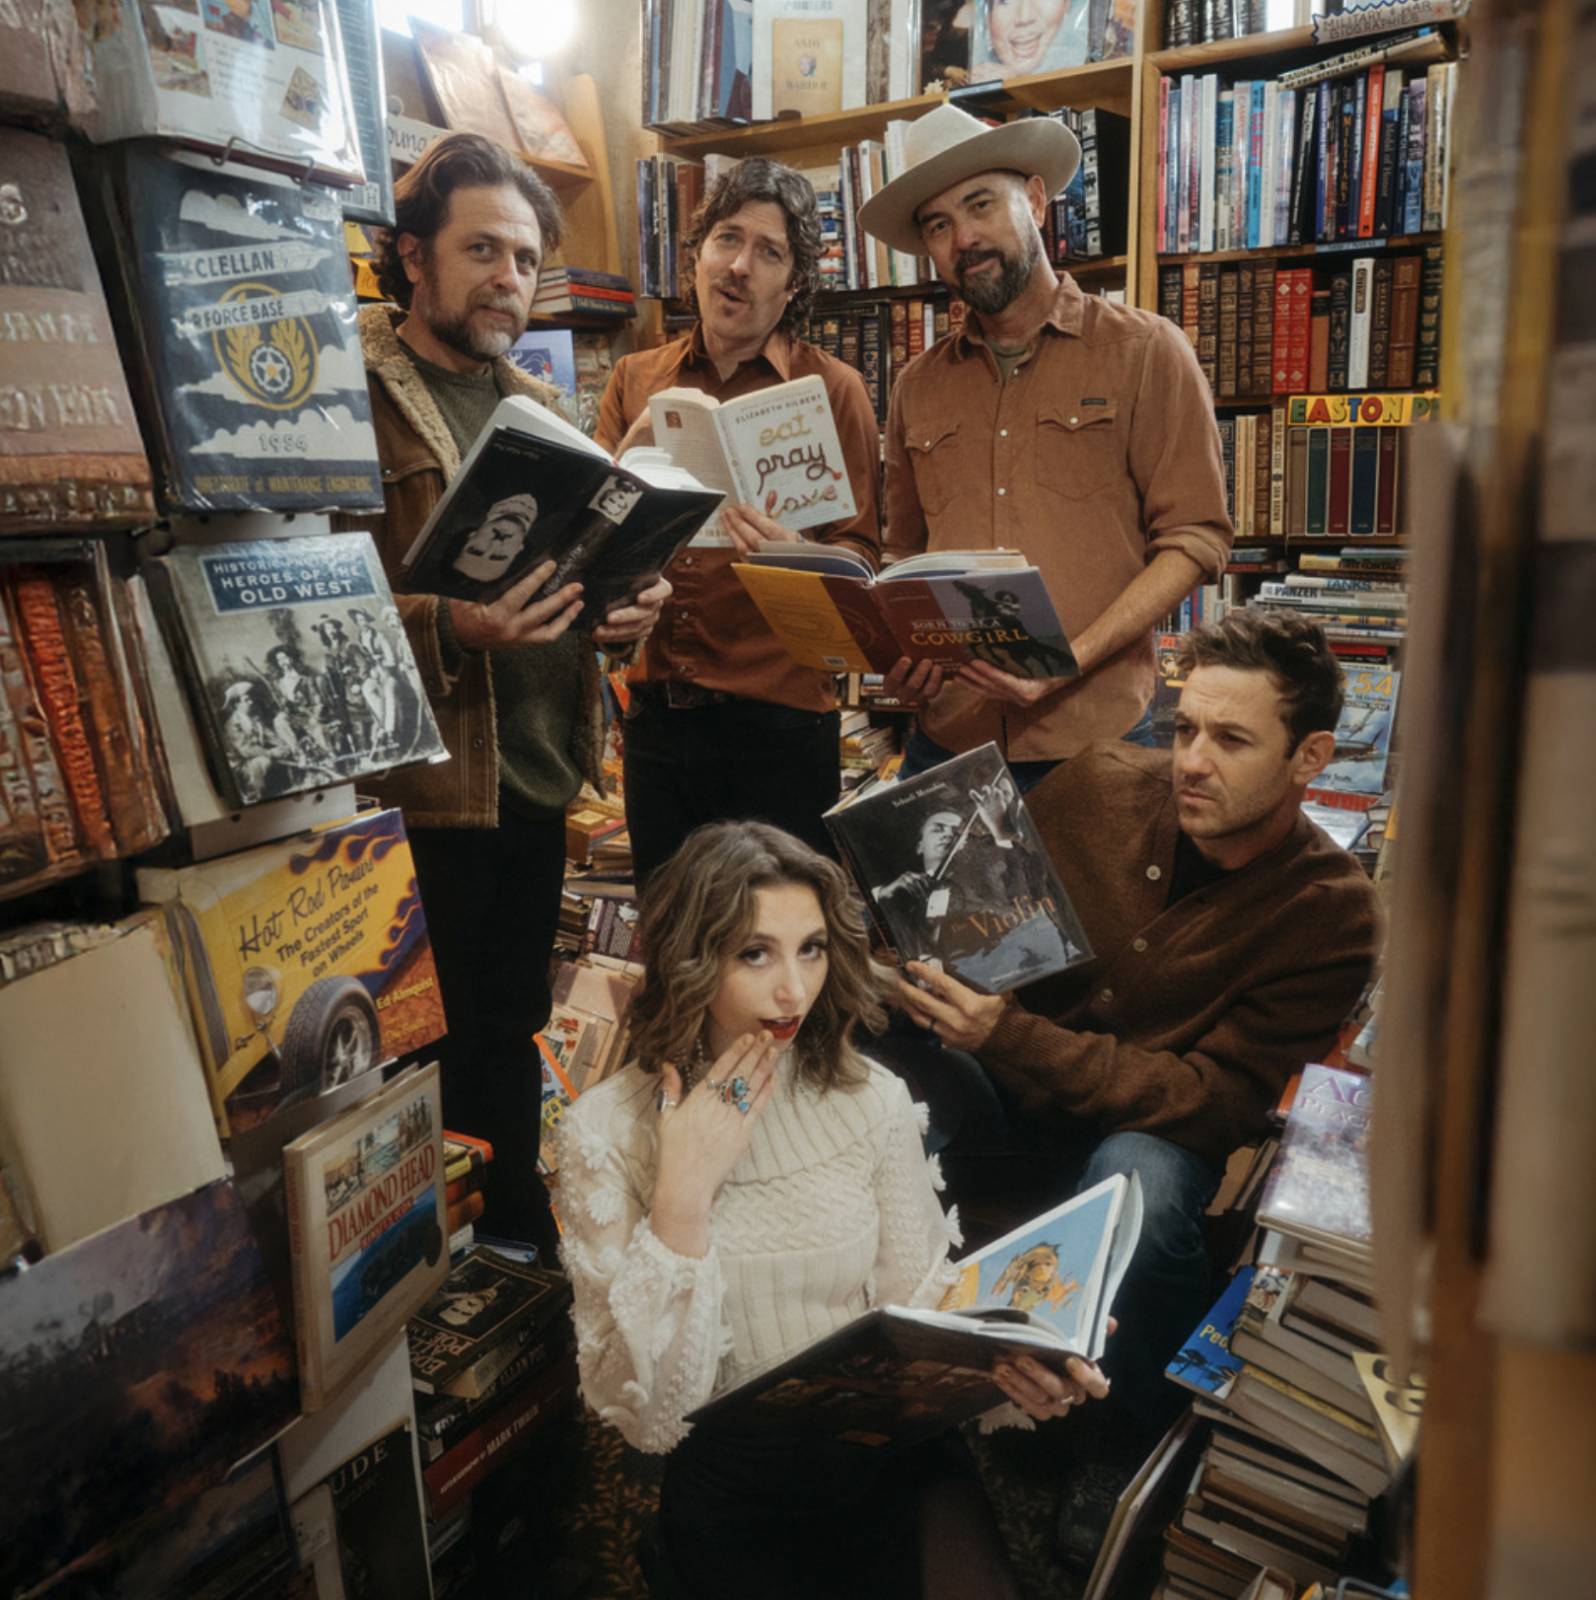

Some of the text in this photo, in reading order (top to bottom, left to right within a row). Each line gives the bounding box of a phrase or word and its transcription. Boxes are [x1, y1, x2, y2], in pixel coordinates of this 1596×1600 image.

[203, 304, 249, 327] FORCE
[251, 299, 285, 320] BASE
[735, 392, 822, 425] ELIZABETH GILBERT
[1290, 395, 1404, 424] EASTON
[758, 413, 812, 448] eat
[756, 443, 838, 497] pray
[763, 484, 838, 520] love
[220, 570, 294, 589] HEROES
[299, 568, 320, 582] OF
[239, 579, 354, 605] OLD WEST
[1274, 586, 1318, 599] PANZER
[1326, 578, 1372, 591] TANKS
[911, 627, 1030, 646] COWGIRL
[239, 909, 286, 961] Hot
[287, 878, 325, 926] Rod
[275, 883, 379, 963] The Creators of the
[966, 895, 1058, 938] Violin
[300, 907, 369, 968] Fastest Sport
[312, 930, 365, 978] on Wheels
[376, 994, 391, 1009] Ed
[327, 1170, 399, 1262] DIAMOND
[400, 1142, 437, 1200] HEAD
[432, 1332, 473, 1357] POE
